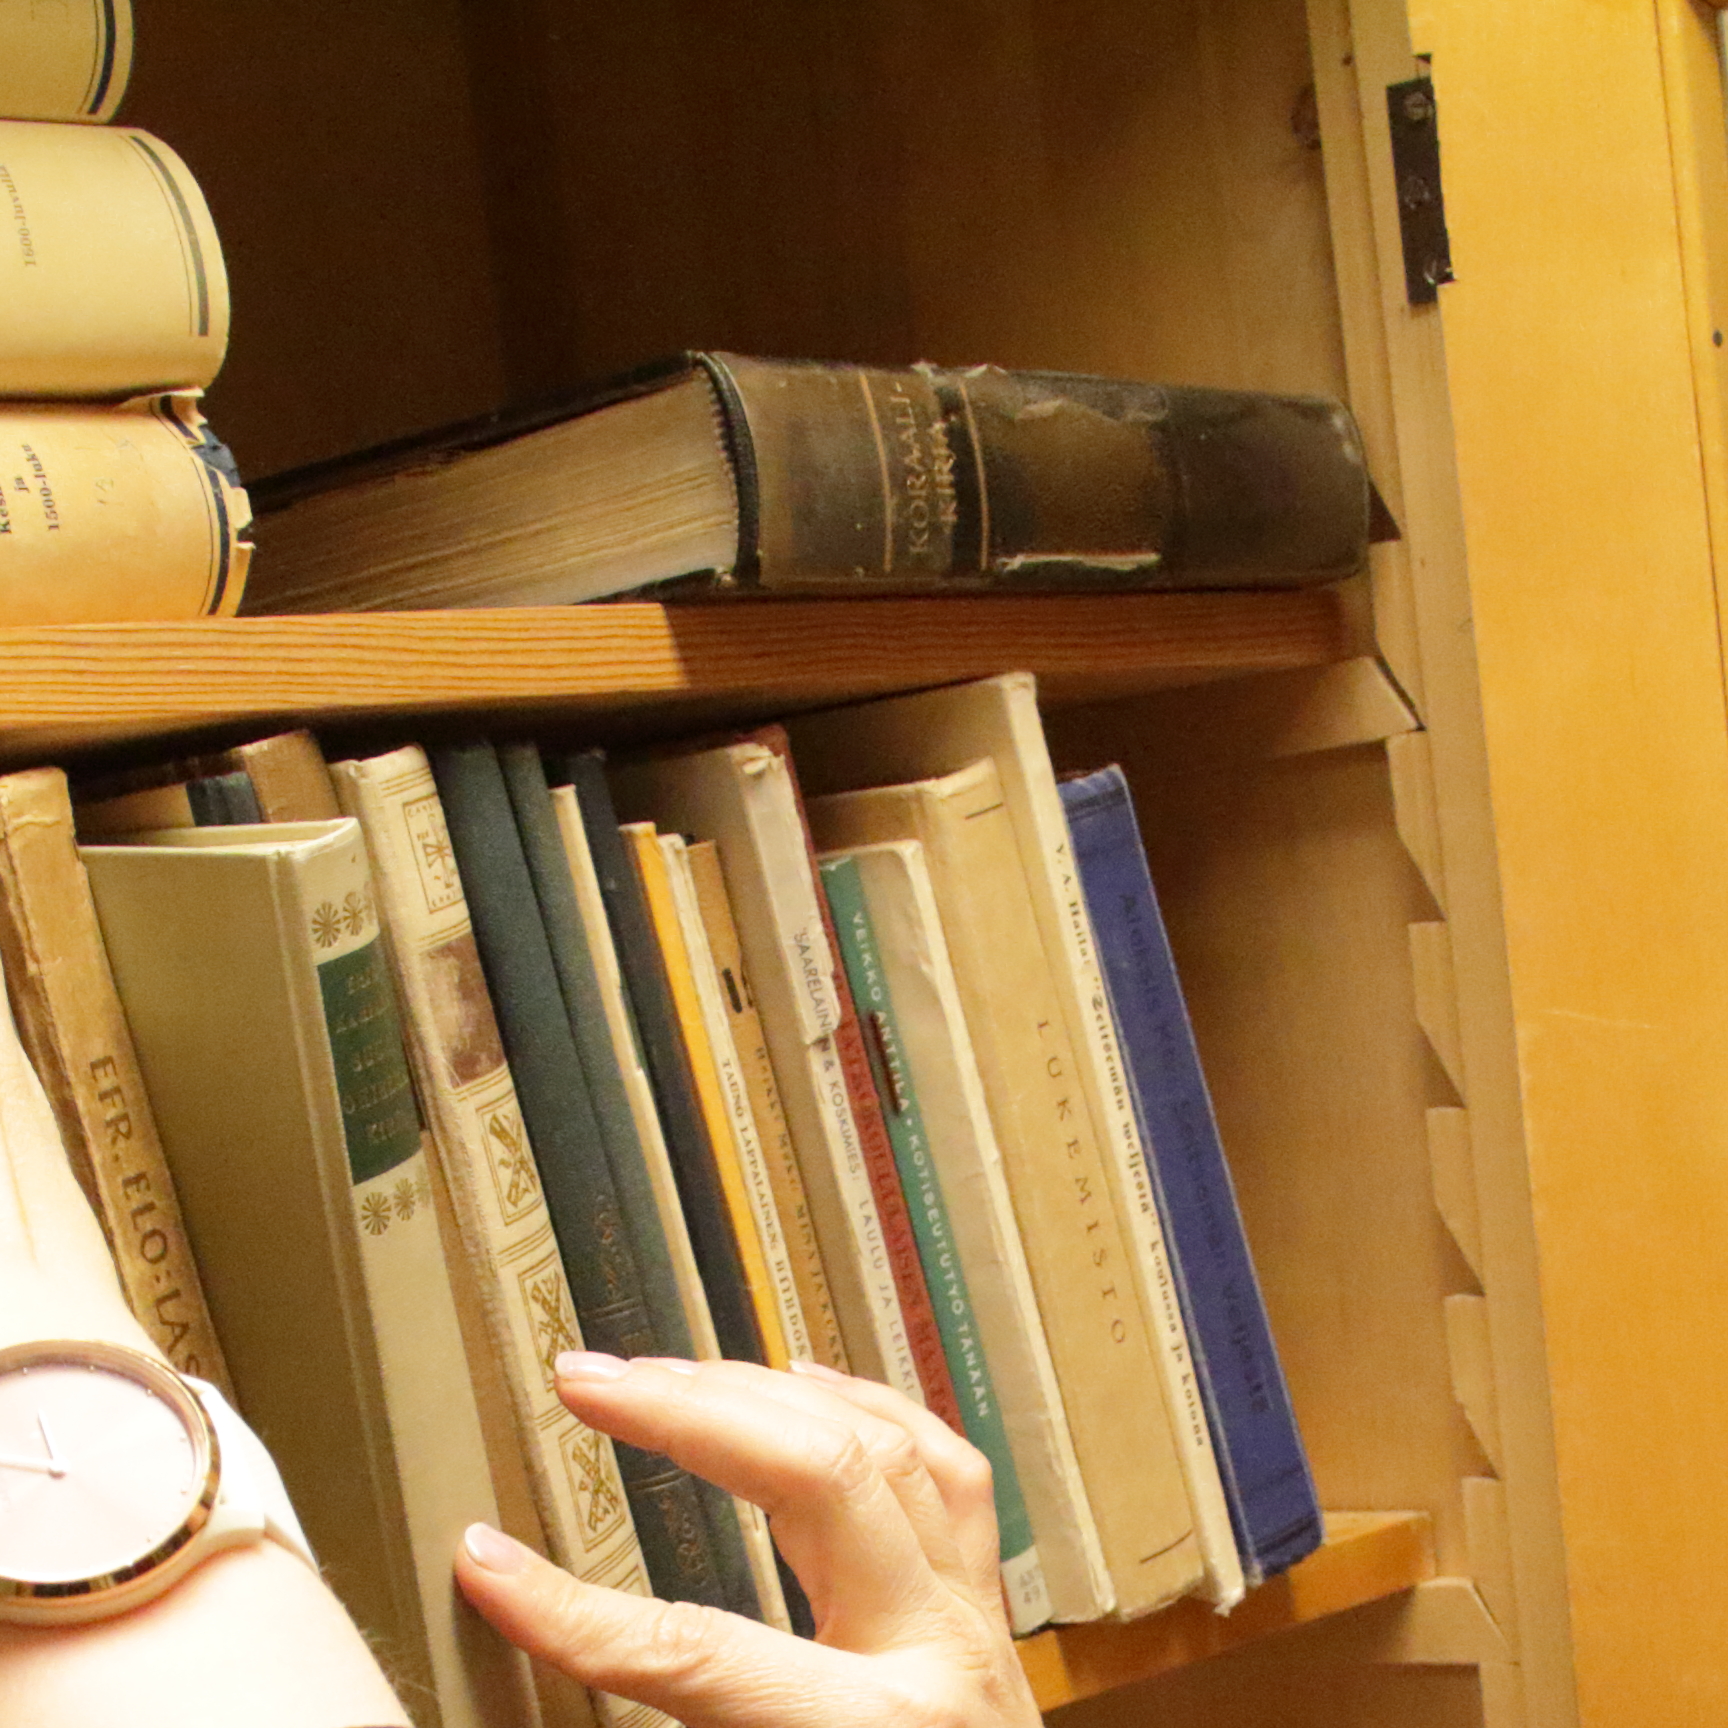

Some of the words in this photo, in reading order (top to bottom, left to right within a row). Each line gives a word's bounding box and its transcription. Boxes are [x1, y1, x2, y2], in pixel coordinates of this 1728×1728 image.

[21, 444, 59, 531] 1500-luku
[723, 1058, 744, 1119] TAUNO
[853, 911, 882, 1001] VEIKKO
[877, 1011, 910, 1112] ANTTILA
[89, 1054, 134, 1163] EFR.
[156, 1287, 202, 1376] LAS
[823, 1059, 835, 1074] &
[858, 1200, 885, 1272] LAULU
[879, 1284, 894, 1311] JA
[1037, 1018, 1126, 1344] LUKEMISTO
